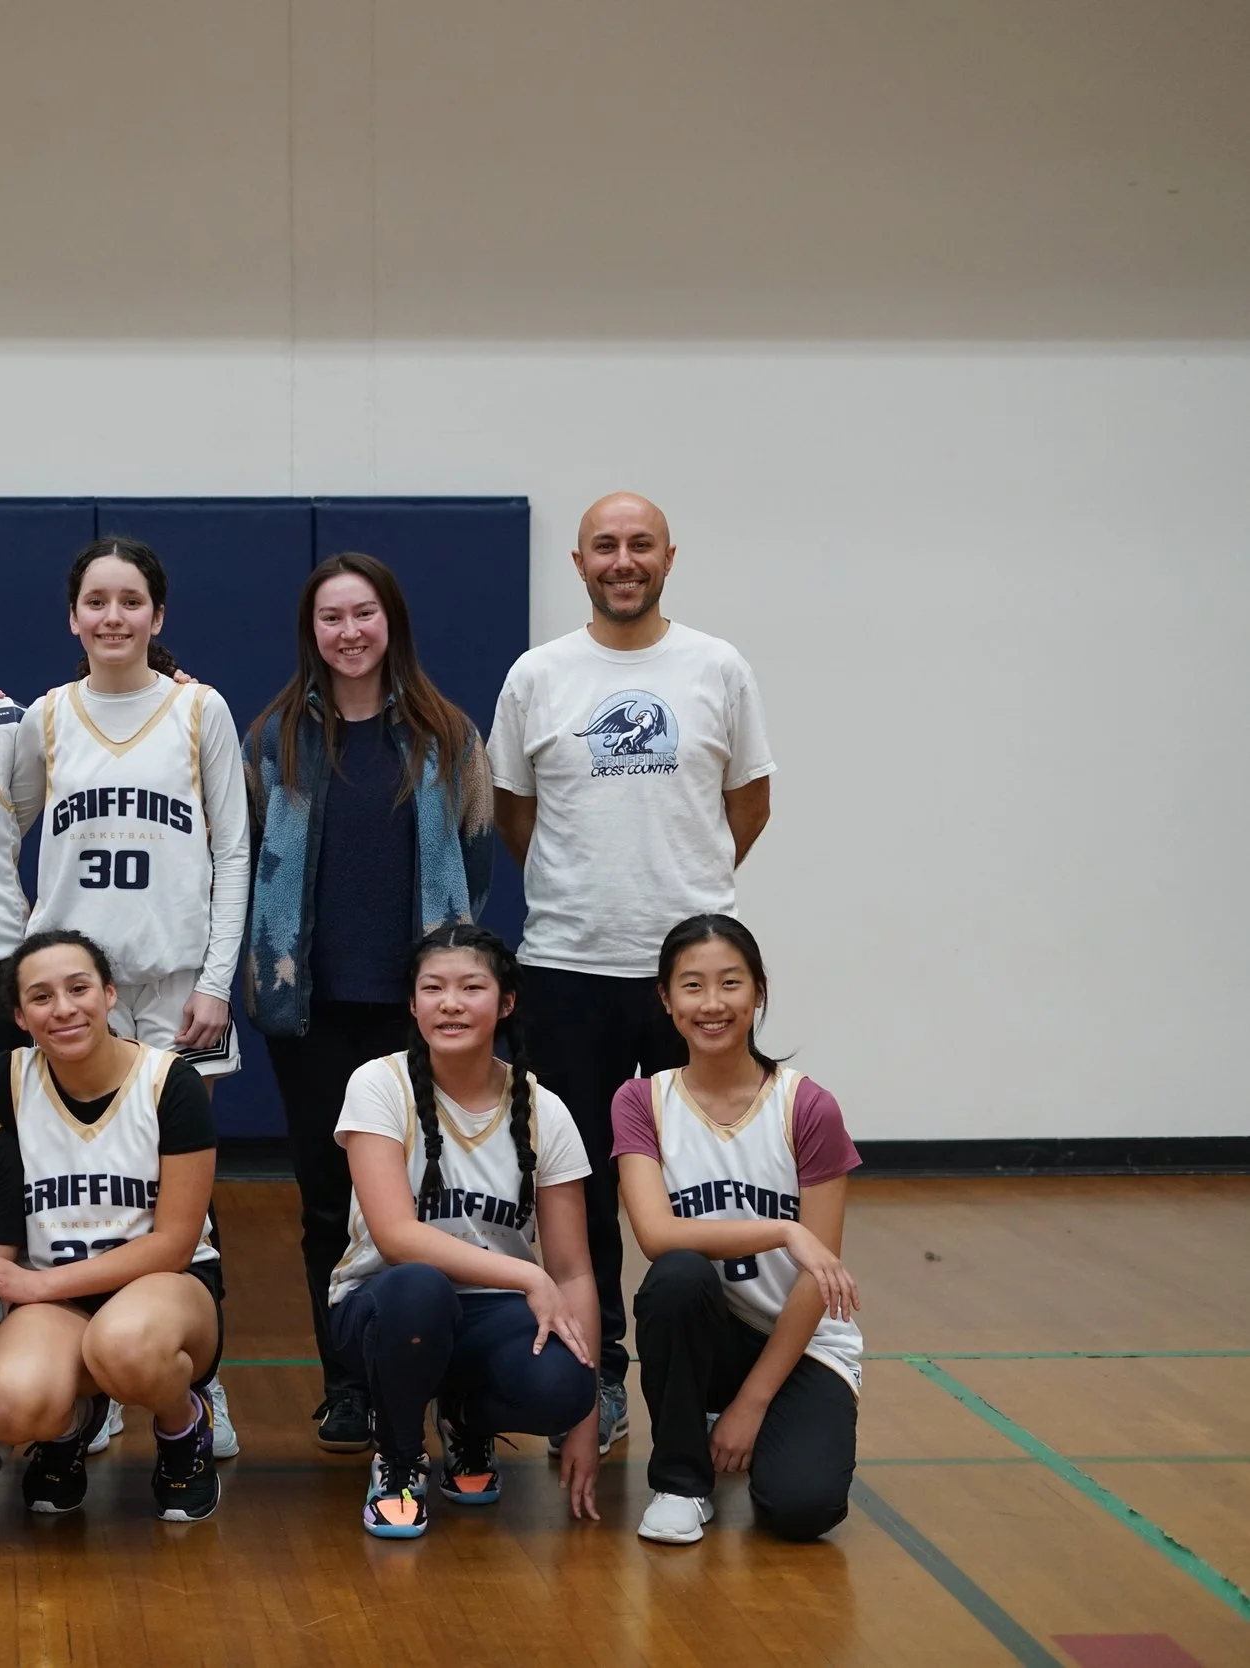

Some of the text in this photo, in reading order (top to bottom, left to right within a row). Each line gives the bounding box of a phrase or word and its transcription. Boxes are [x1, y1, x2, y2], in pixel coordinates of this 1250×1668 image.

[592, 752, 676, 769] GRIFFINS
[591, 763, 679, 778] CROSS COUNTRY
[52, 787, 193, 837] GRIFFINS
[69, 831, 166, 842] BASKETBALL
[79, 849, 151, 890] 30
